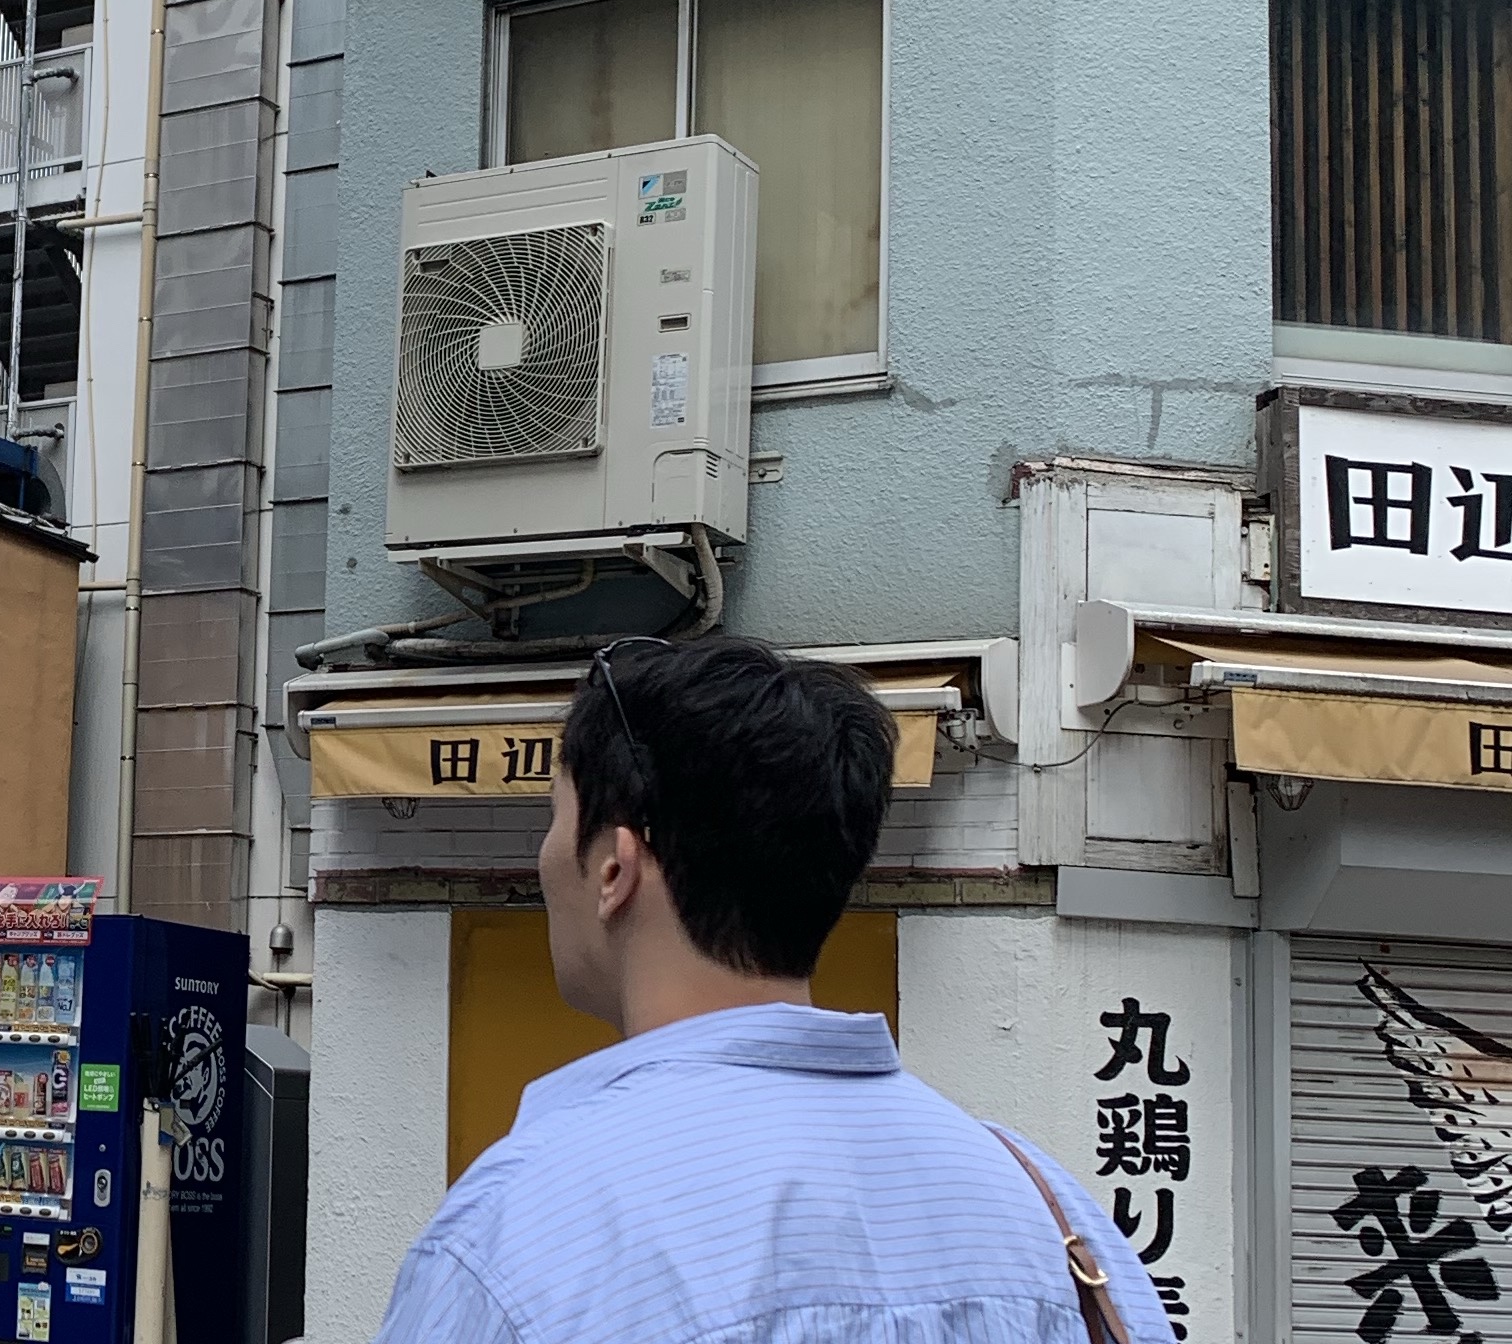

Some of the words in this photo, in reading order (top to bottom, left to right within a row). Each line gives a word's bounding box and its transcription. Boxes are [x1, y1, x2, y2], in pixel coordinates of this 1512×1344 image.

[1324, 454, 1512, 562] 田辺
[430, 733, 553, 786] 田辺
[174, 976, 219, 995] SUNTORY
[215, 1047, 225, 1083] BOSS
[205, 1088, 226, 1134] COFFEE
[173, 1137, 225, 1182] OSS
